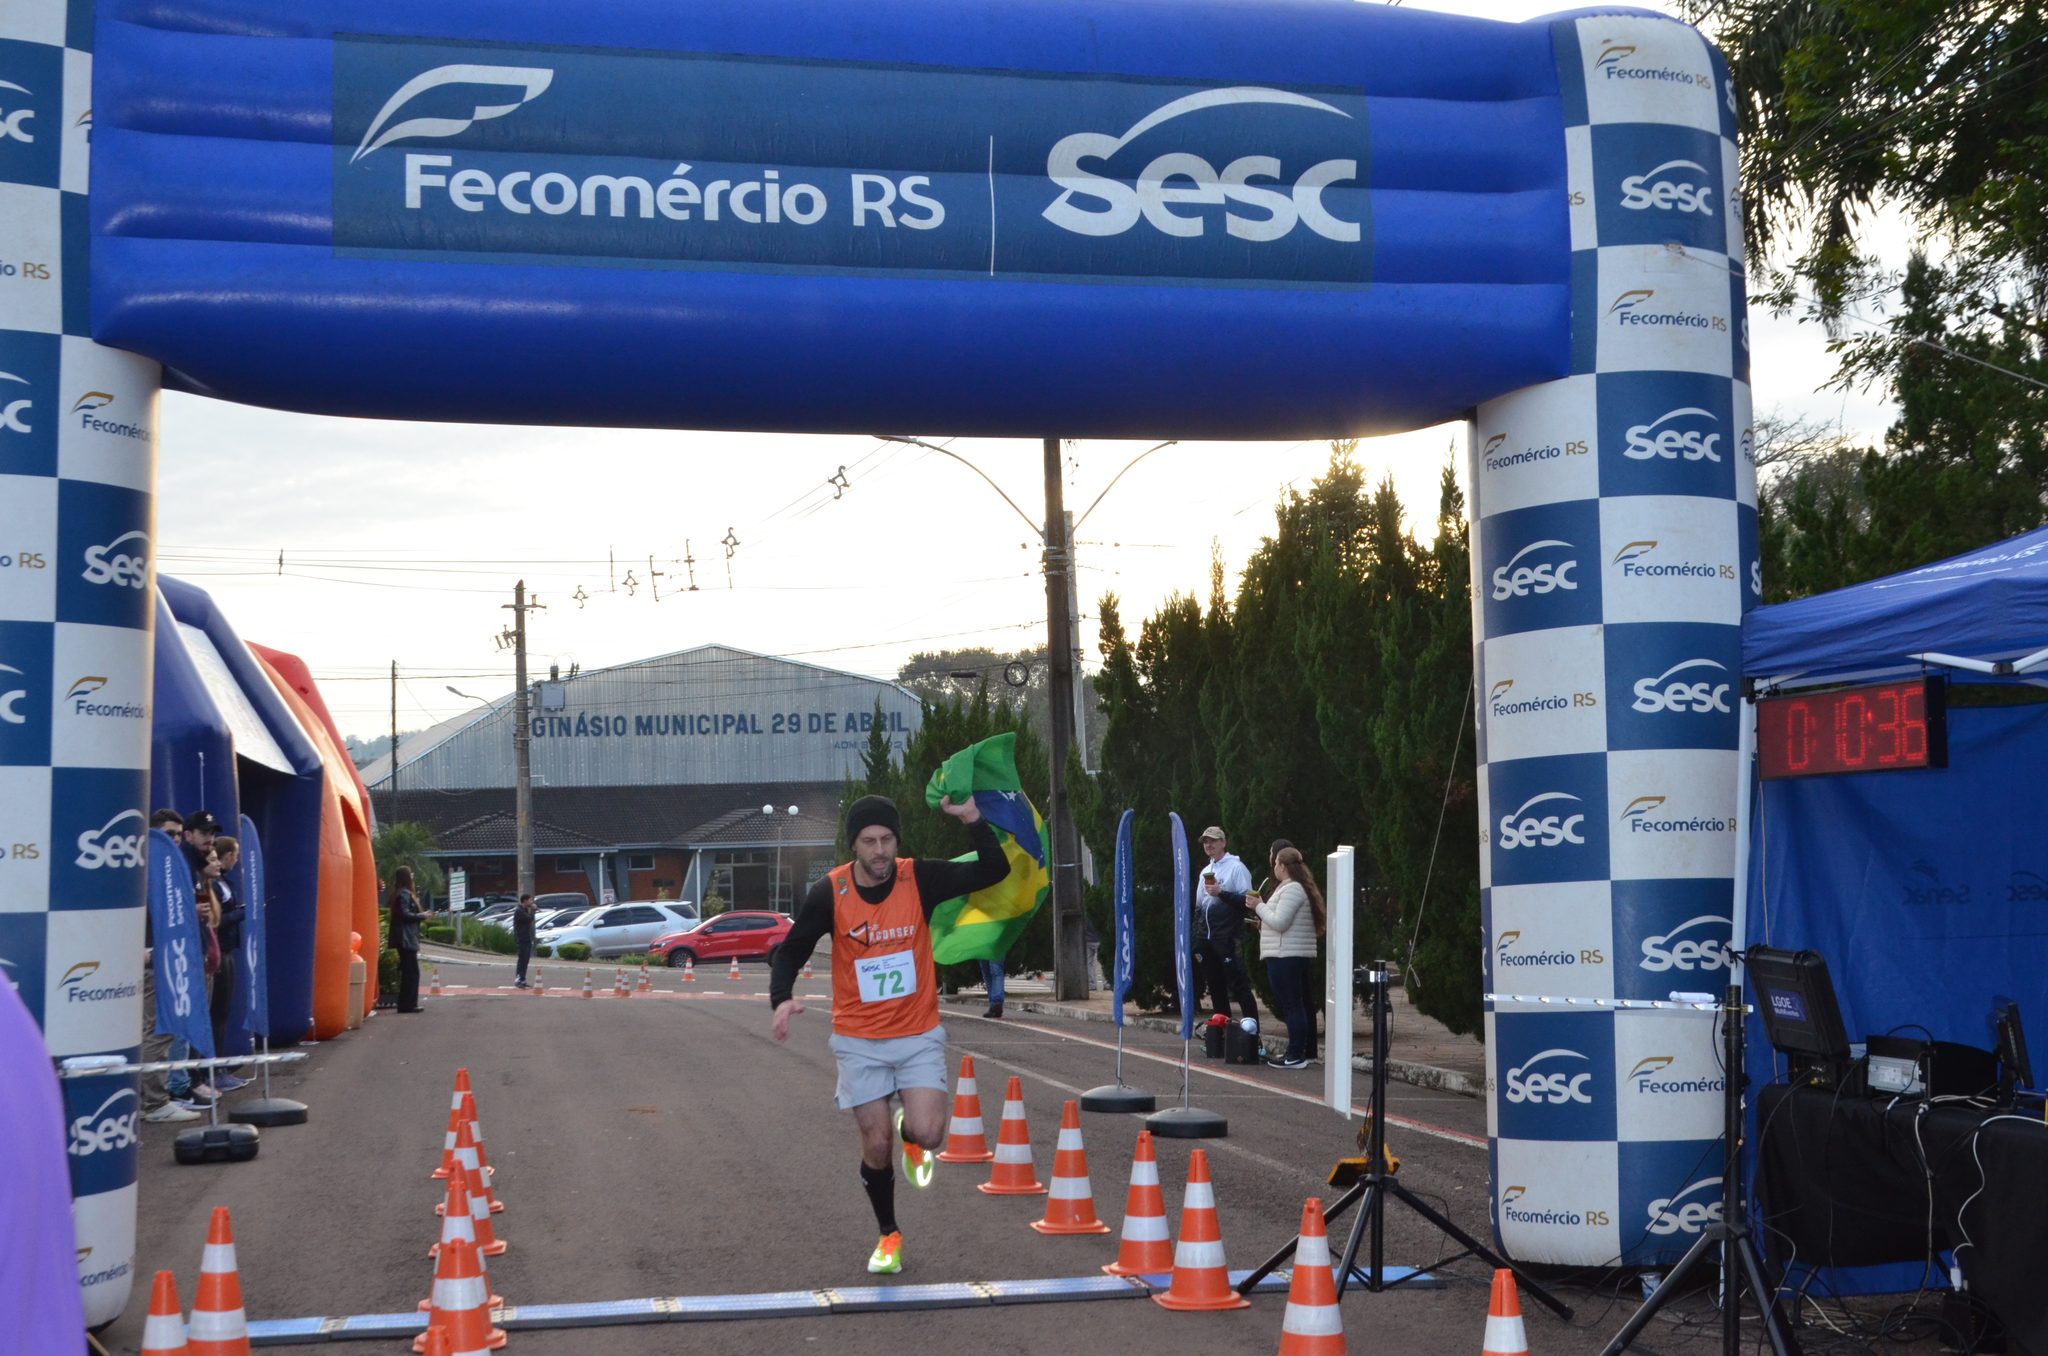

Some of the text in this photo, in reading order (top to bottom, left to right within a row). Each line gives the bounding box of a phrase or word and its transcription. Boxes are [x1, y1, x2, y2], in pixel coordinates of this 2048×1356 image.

[1606, 66, 1711, 90] Fecomércio RS
[1041, 109, 1361, 242] Sesc
[405, 154, 945, 230] Fecomércio RS
[1620, 168, 1713, 216] Sesc
[22, 262, 50, 280] RS
[1619, 311, 1727, 332] Fecomércio RS
[1622, 416, 1721, 462] Sesc
[1486, 441, 1588, 472] Fecomércio RS
[18, 552, 46, 569] RS
[1623, 562, 1715, 577] Fecomércio
[1719, 565, 1735, 580] RS
[1492, 551, 1578, 600] Sesc
[1493, 696, 1567, 717] Fecomércio
[1573, 692, 1596, 707] RS
[1631, 669, 1730, 713] Sesc
[532, 711, 627, 738] GINÁSIO
[635, 713, 764, 736] MUNICIPAL
[771, 713, 801, 734] 29
[808, 712, 837, 733] DE
[1499, 803, 1585, 849] Sesc
[1631, 817, 1737, 833] Fecomércio R
[11, 843, 39, 860] RS
[1500, 951, 1575, 967] Fecomércio
[1580, 950, 1604, 964] RS
[169, 937, 191, 1017] Sesc
[872, 970, 905, 997] 72
[1506, 1058, 1592, 1104] Sesc
[1638, 1077, 1725, 1093] Fecomérci
[1505, 1206, 1581, 1225] Fecomércio
[1586, 1210, 1610, 1226] RS
